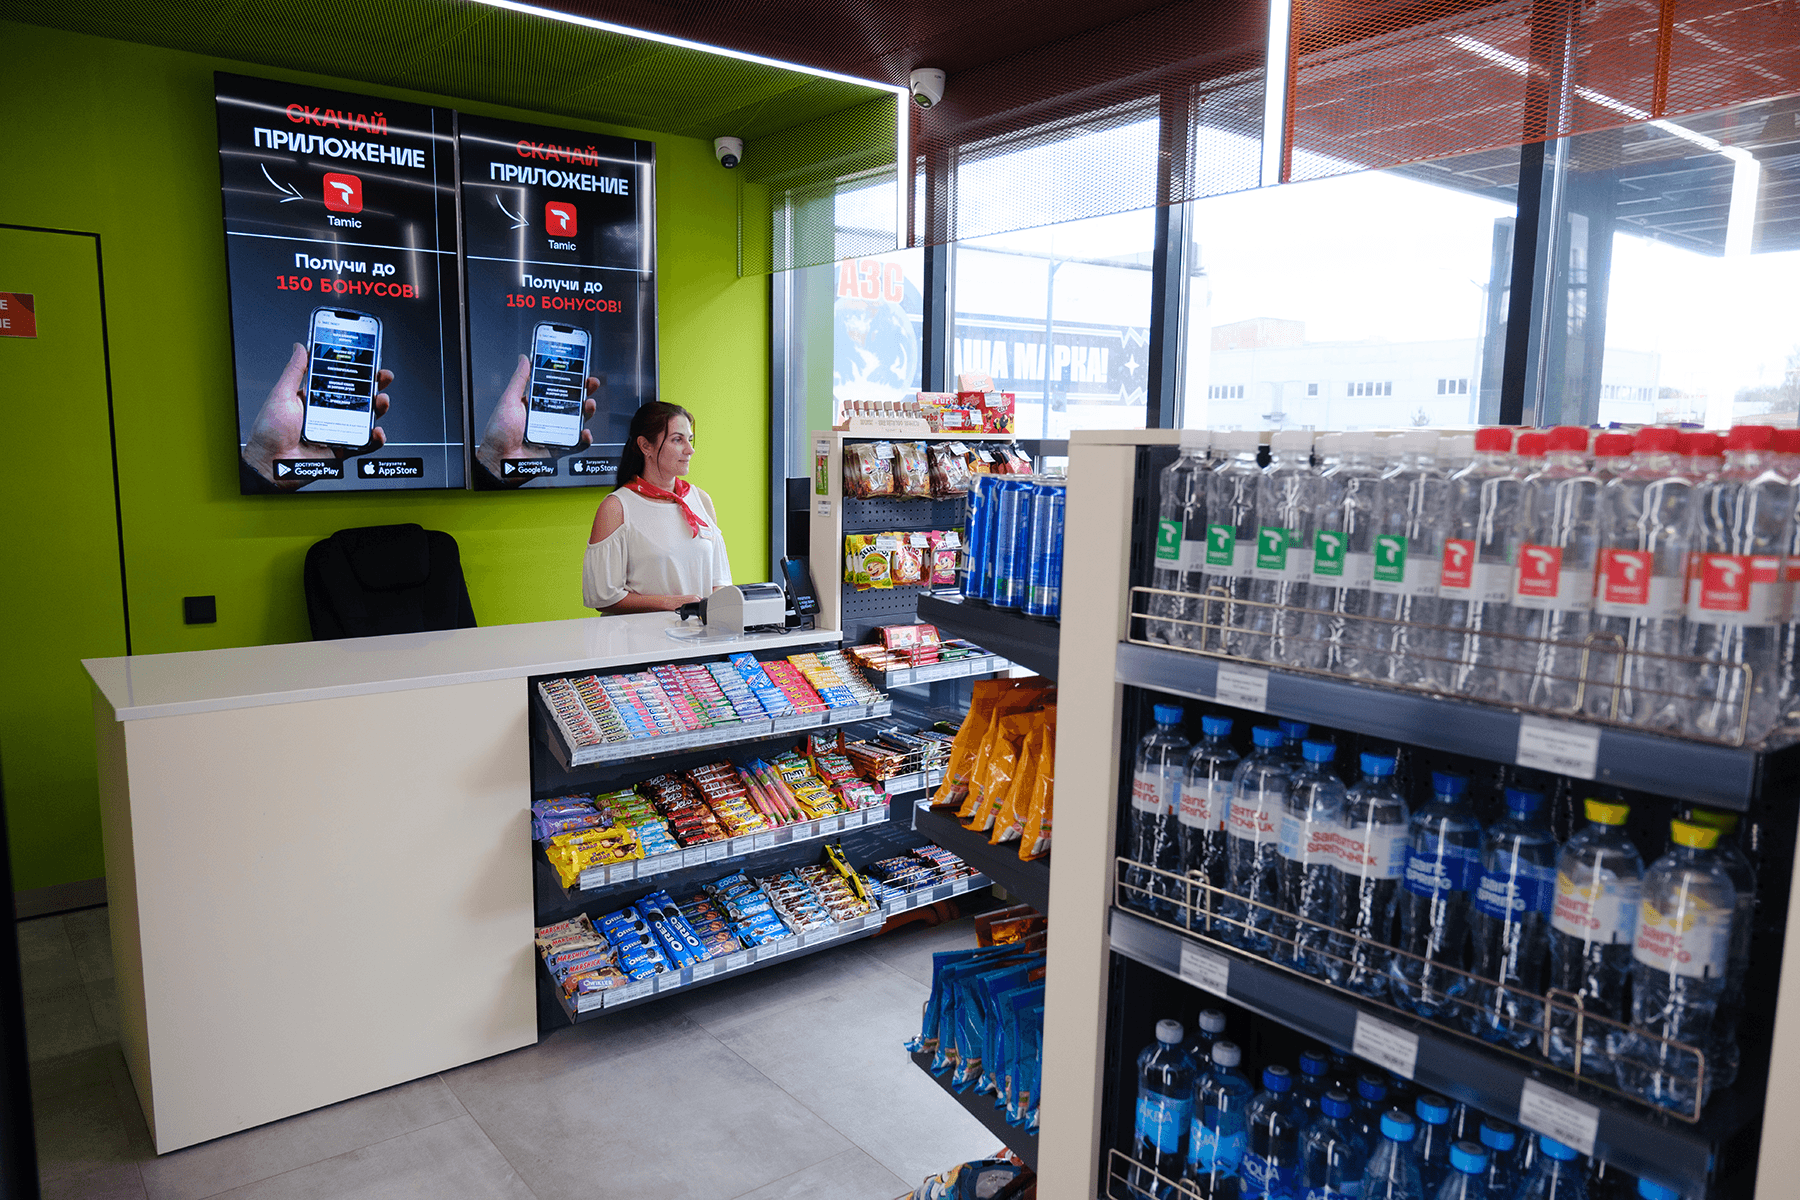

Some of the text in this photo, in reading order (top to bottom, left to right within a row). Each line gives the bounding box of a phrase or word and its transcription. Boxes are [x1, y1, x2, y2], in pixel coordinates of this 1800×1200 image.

[285, 103, 388, 136] СКАЧАЙ
[253, 127, 425, 168] ПРИЛОЖЕНИЕ
[516, 140, 599, 168] СКАЧАЙ
[490, 162, 629, 196] ПРИЛОЖЕНИЕ
[326, 215, 362, 229] Tamic
[548, 239, 577, 252] Tamic
[294, 252, 396, 276] Получи до
[276, 274, 420, 300] 150 БОНУСОВ!
[521, 274, 603, 294] Получи до
[837, 257, 904, 304] АЗС
[506, 294, 622, 314] 150 БОНУСОВ!
[294, 467, 340, 477] Google Play
[378, 466, 418, 477] App Store
[518, 465, 555, 475] Google Play
[586, 463, 618, 473] App Store
[605, 913, 625, 925] OREO
[617, 926, 636, 938] OREO
[654, 921, 684, 952] OREO
[670, 916, 700, 947] OREO
[622, 940, 642, 951] OREO
[629, 954, 648, 965] OREO
[636, 968, 655, 980] OREO
